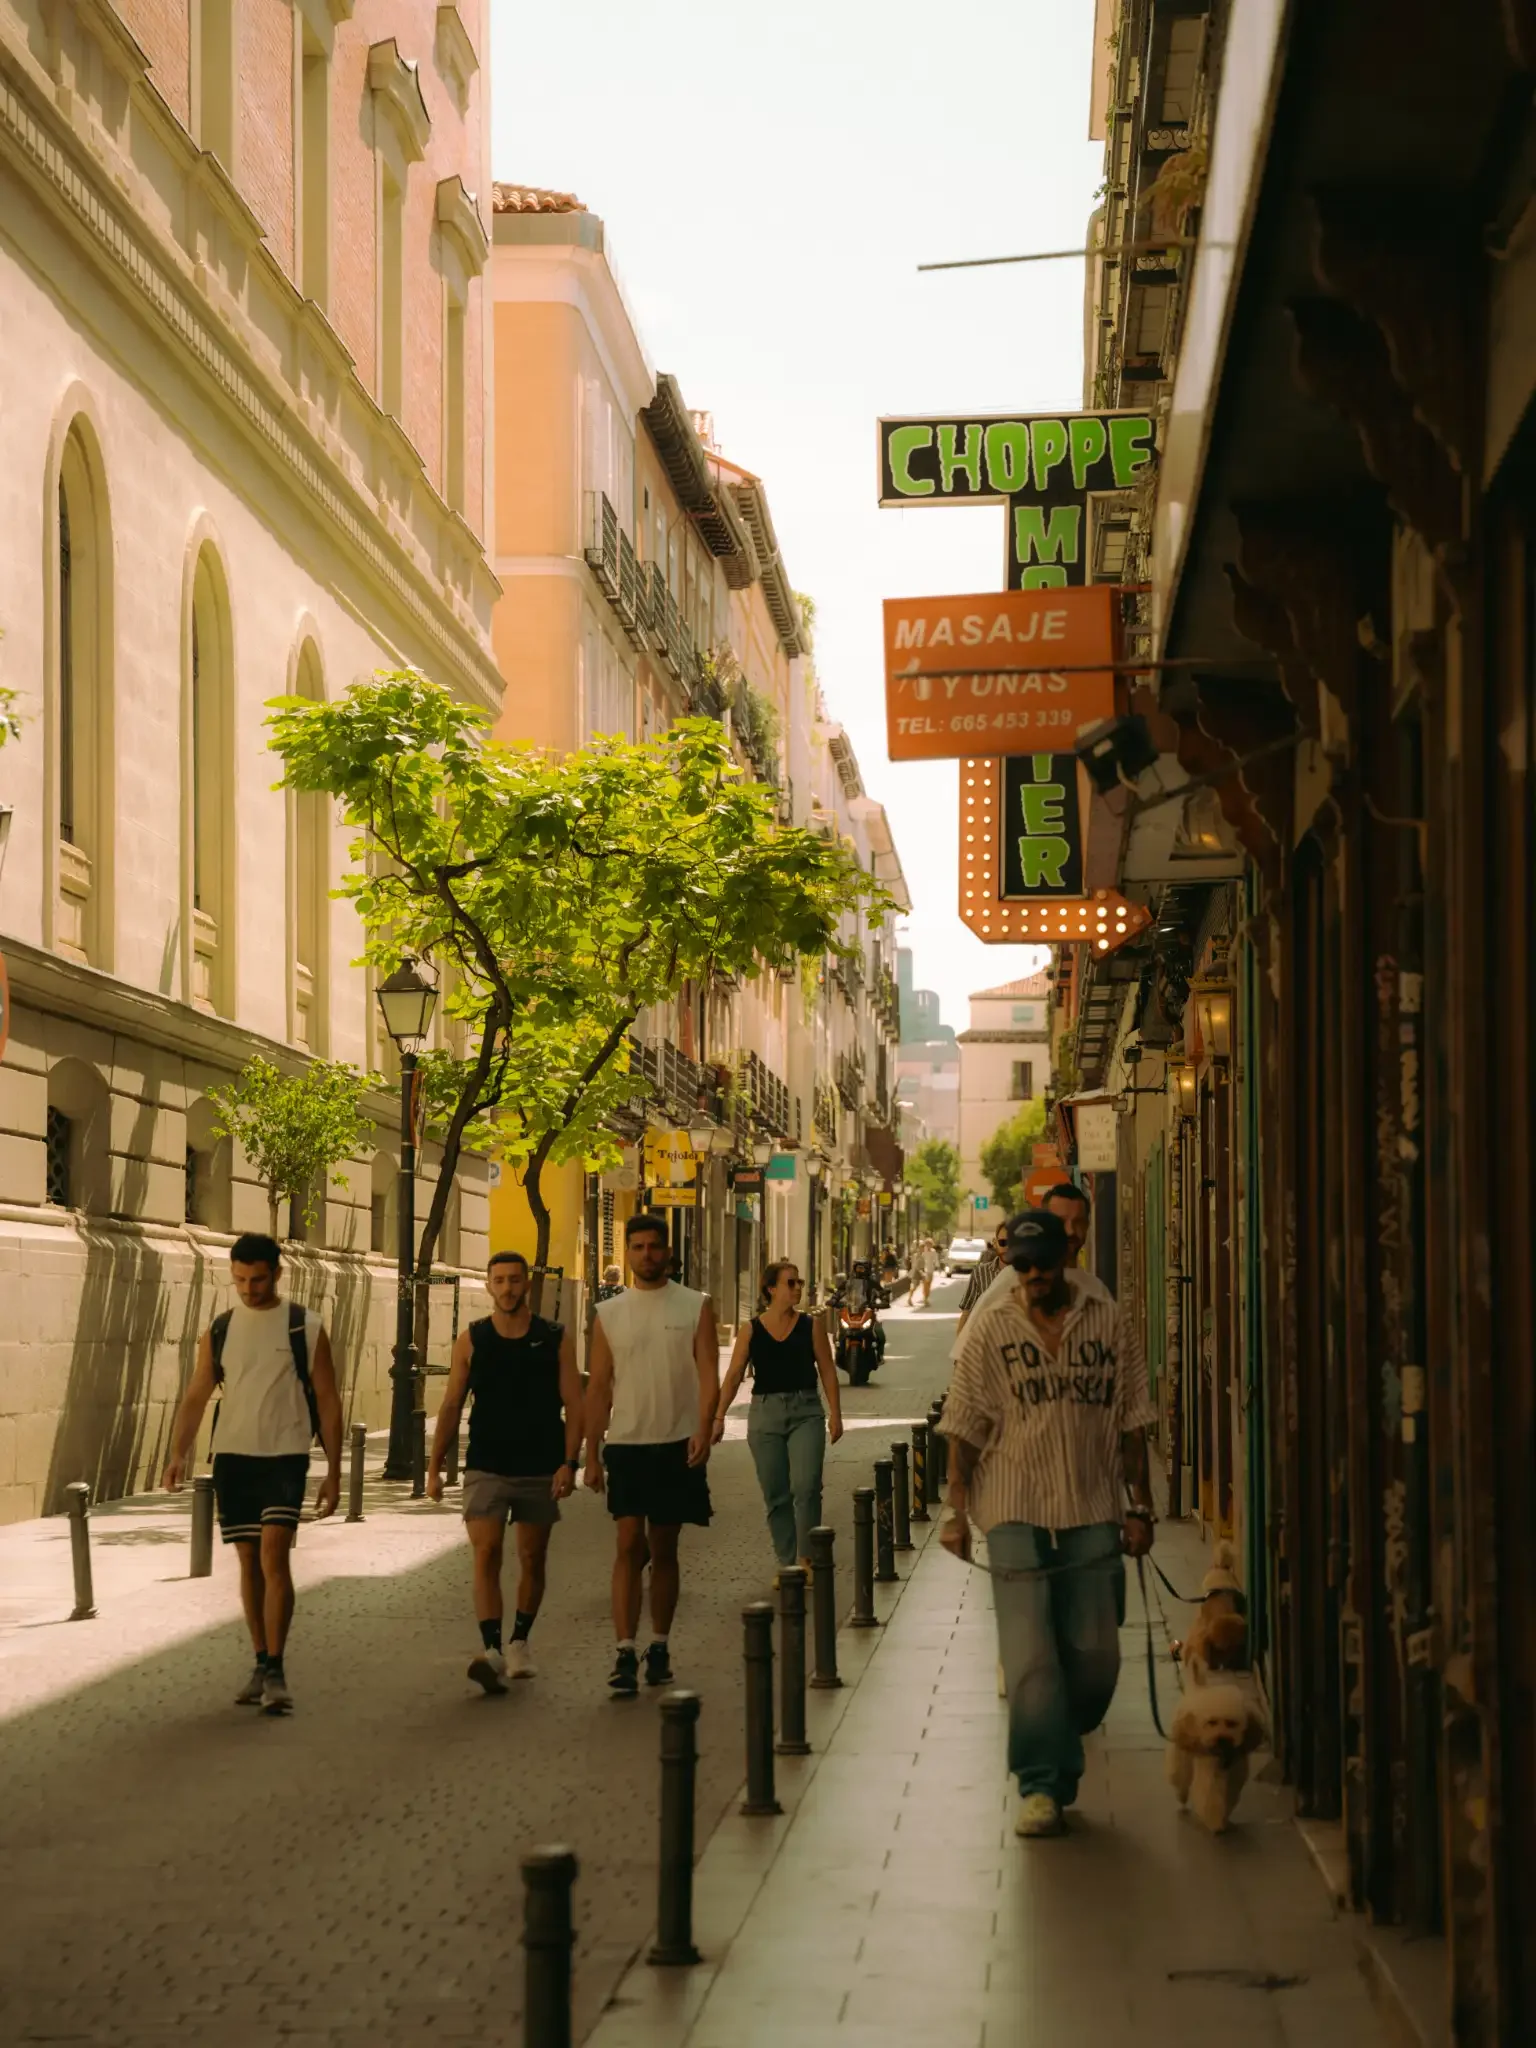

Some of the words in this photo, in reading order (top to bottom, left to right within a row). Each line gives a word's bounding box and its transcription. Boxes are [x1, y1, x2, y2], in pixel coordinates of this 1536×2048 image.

[894, 610, 1068, 649] MASAJE
[941, 670, 963, 699] Y
[896, 717, 944, 735] TEL:
[949, 712, 988, 732] 665
[991, 711, 1029, 730] 453
[1035, 709, 1073, 728] 339
